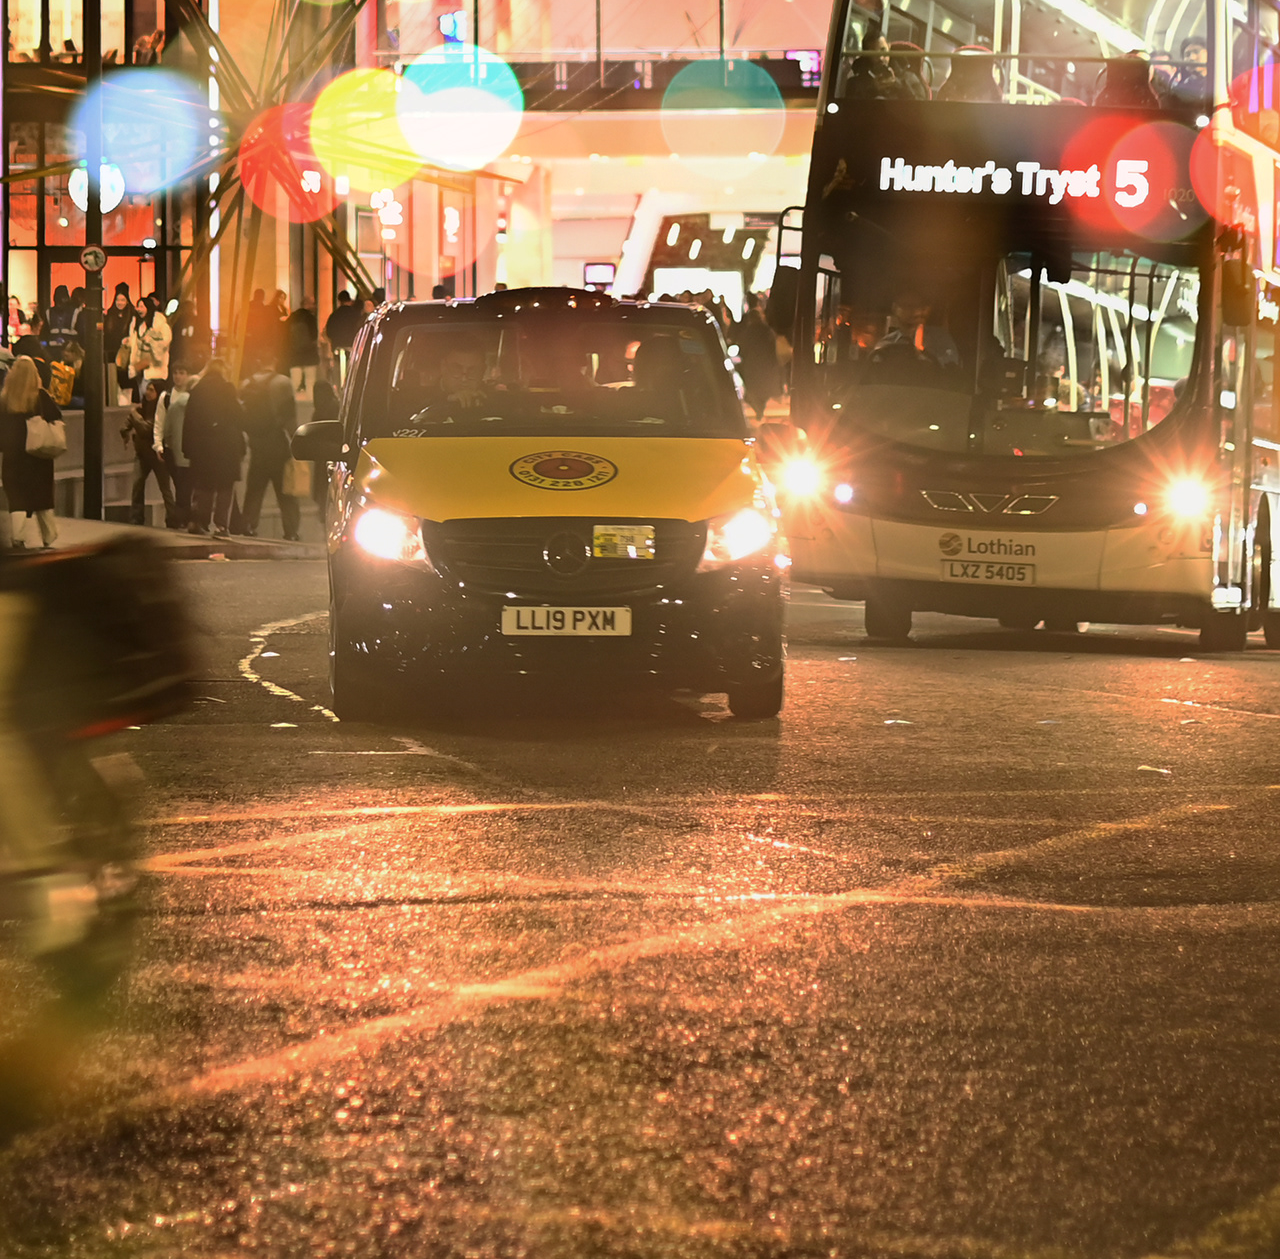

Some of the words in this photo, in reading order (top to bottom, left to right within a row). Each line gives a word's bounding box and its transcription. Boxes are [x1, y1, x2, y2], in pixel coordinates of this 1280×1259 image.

[879, 157, 1012, 195] Hunter's
[1016, 161, 1101, 205] Tryst
[1114, 159, 1150, 208] 5
[1163, 187, 1195, 202] 1020
[523, 453, 553, 464] CITY
[561, 452, 603, 464] CABS
[519, 470, 545, 484] 0131
[967, 537, 1036, 557] Lothian
[949, 562, 981, 579] LXZ
[985, 564, 1026, 581] 5405
[516, 609, 565, 631] LL19
[572, 610, 615, 631] PXM
